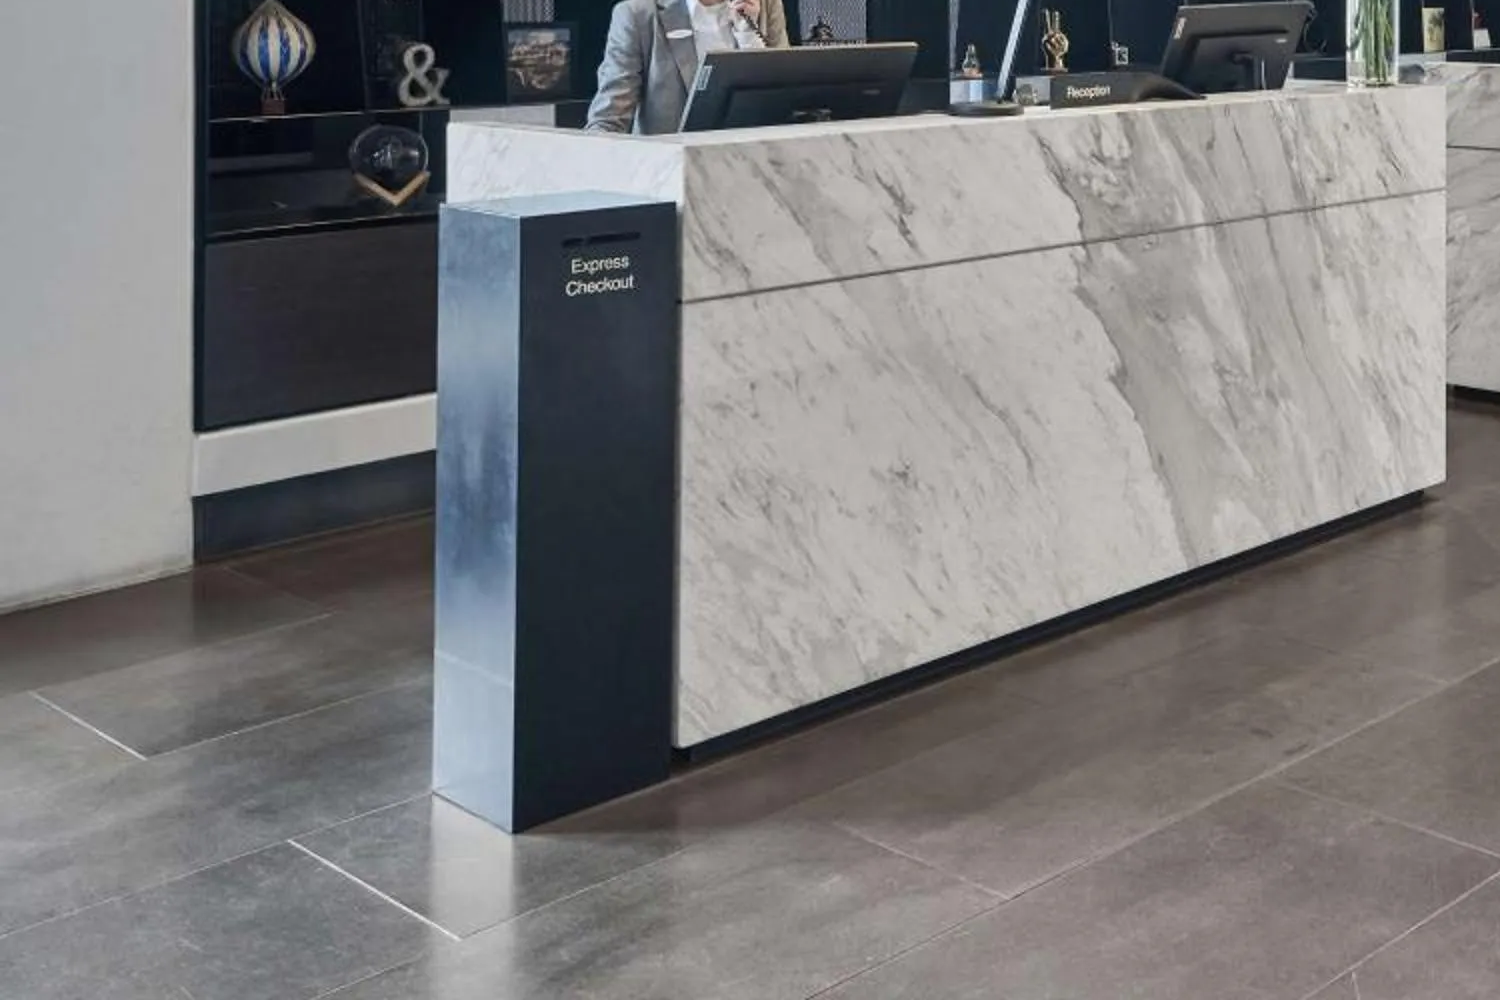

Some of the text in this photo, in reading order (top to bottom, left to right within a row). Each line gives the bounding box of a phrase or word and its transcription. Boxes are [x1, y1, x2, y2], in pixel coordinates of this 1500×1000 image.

[399, 43, 450, 107] &
[1066, 84, 1111, 99] Reception
[571, 255, 630, 275] Express
[565, 273, 634, 297] Checkout
